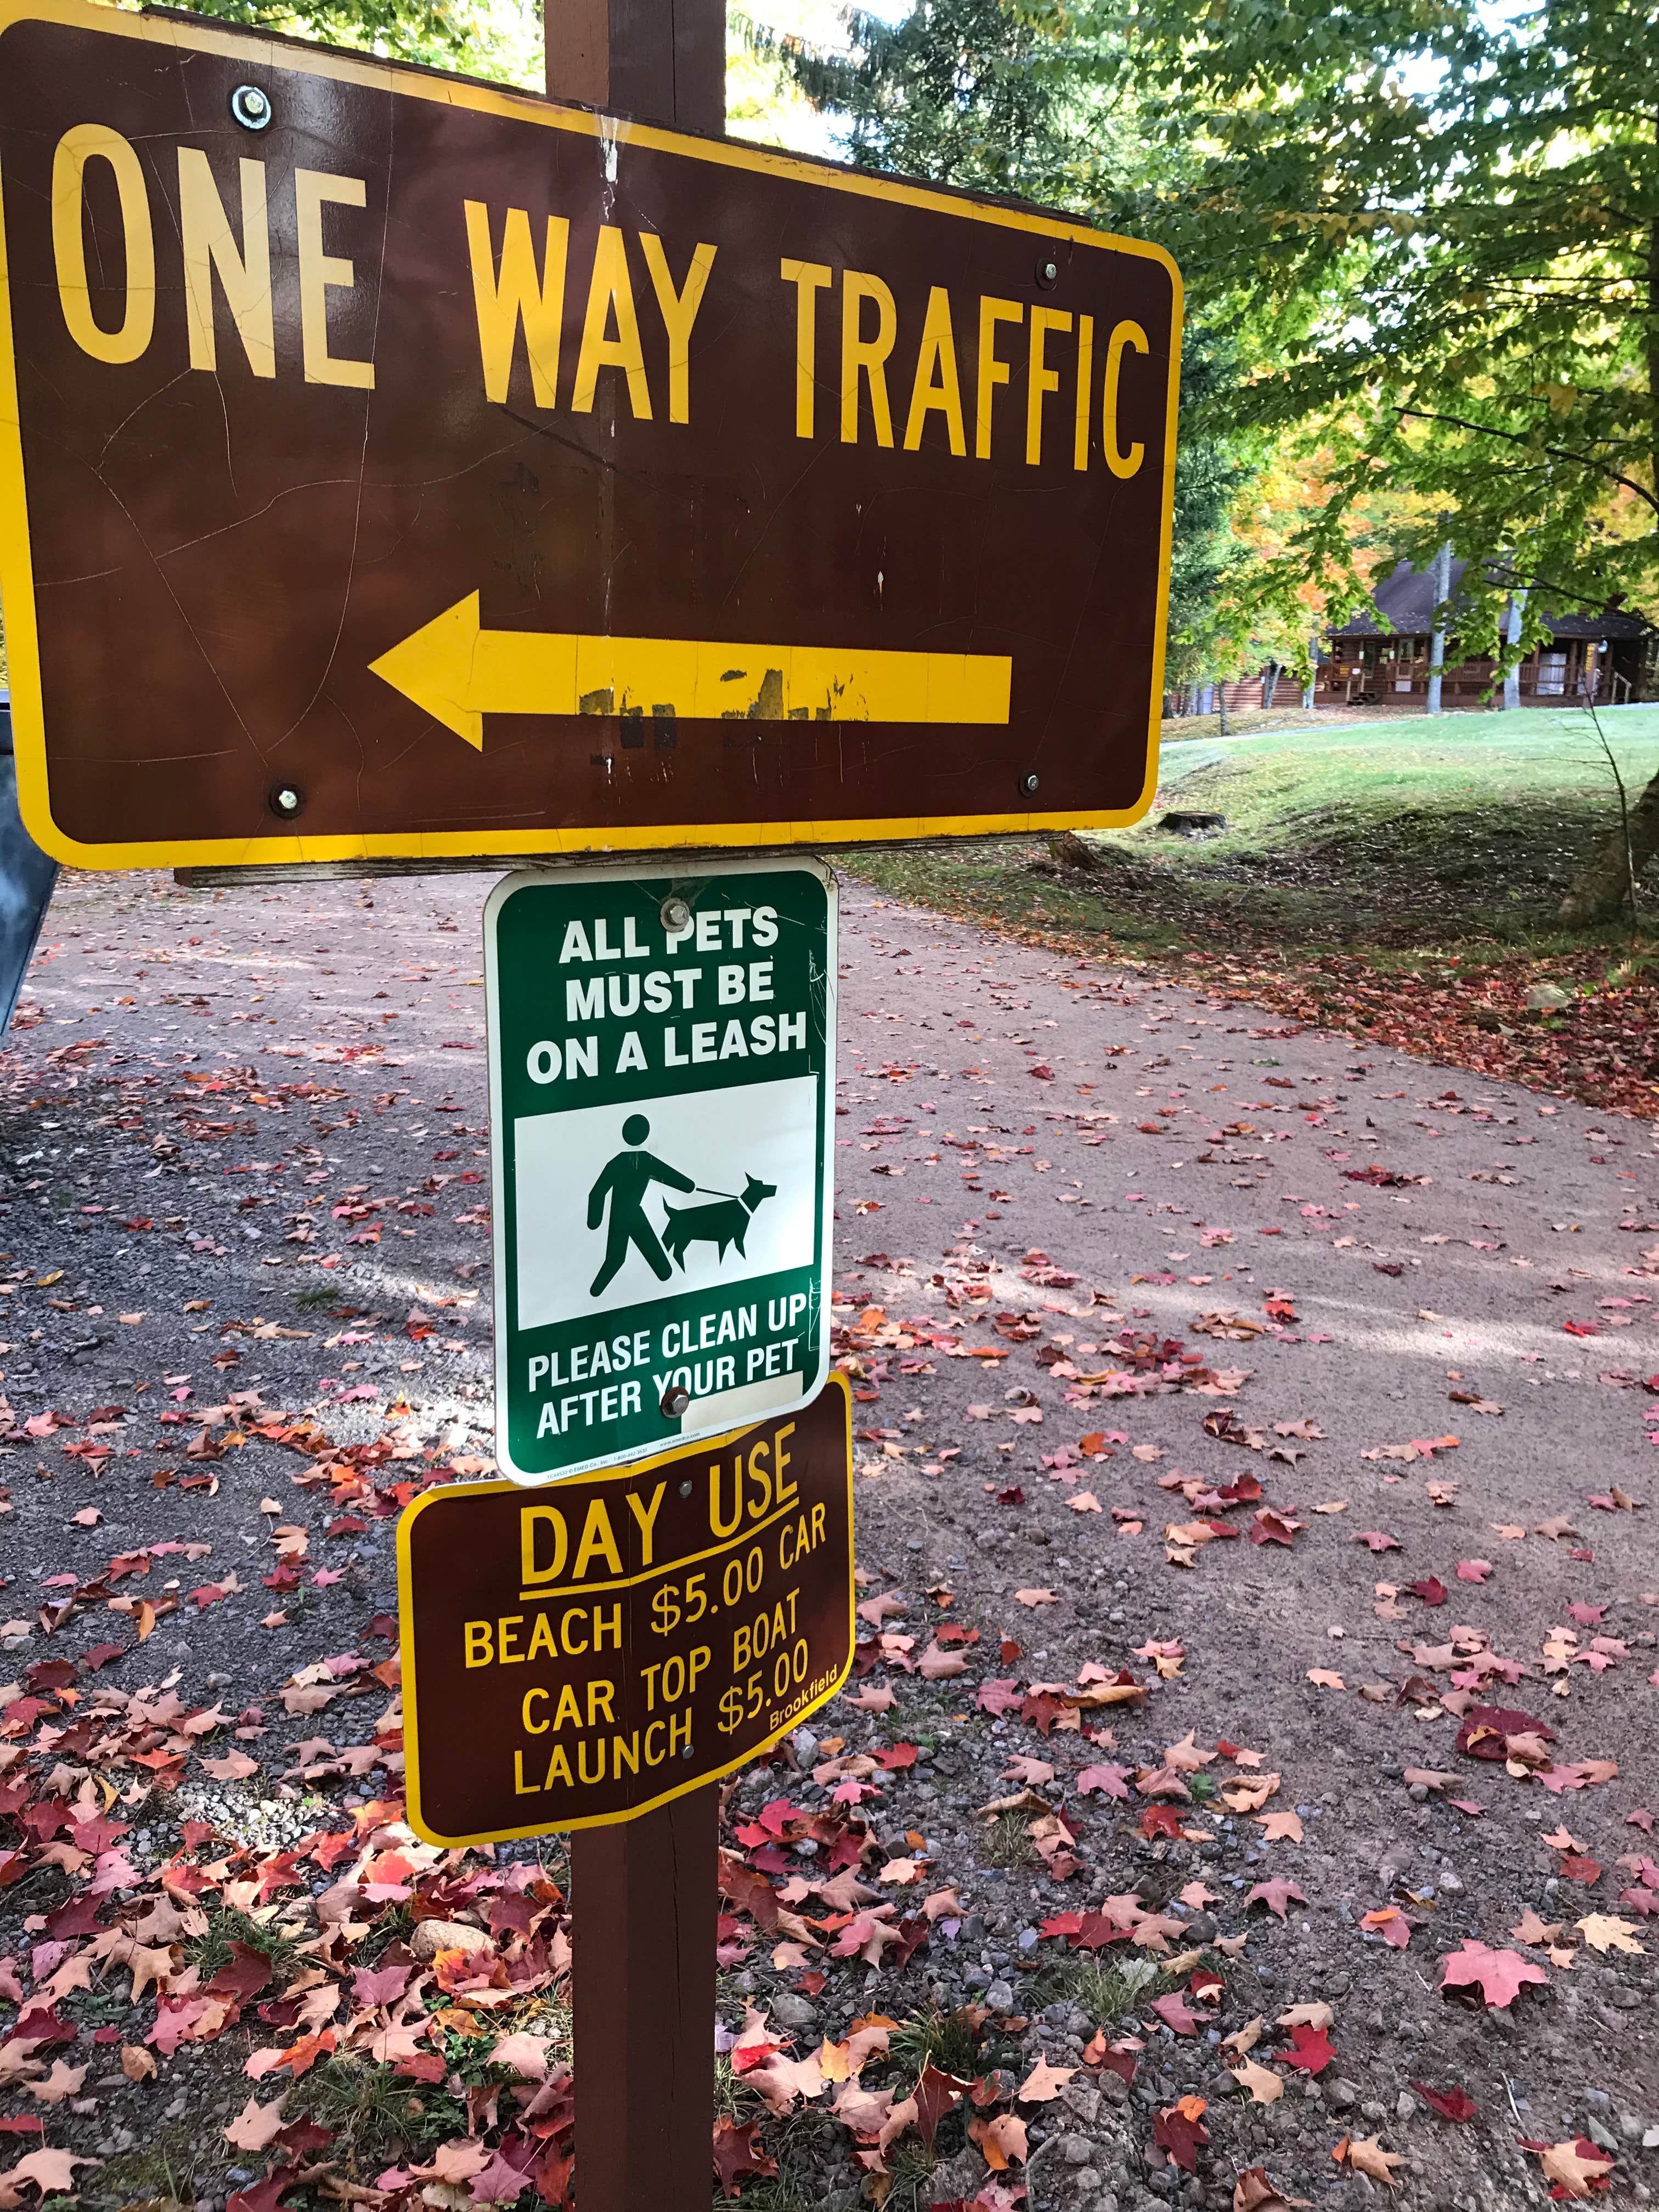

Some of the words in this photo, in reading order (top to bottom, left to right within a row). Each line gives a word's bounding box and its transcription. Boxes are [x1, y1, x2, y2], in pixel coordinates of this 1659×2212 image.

[52, 123, 375, 389] ONE
[464, 199, 718, 424] WAY
[781, 257, 1149, 478] TRAFFIC
[559, 917, 650, 963] ALL
[666, 906, 778, 955] PETS
[566, 968, 702, 1022] MUST
[718, 961, 775, 1006] BE
[526, 1036, 599, 1085] ON
[615, 1031, 648, 1074] A
[664, 1011, 807, 1067] LEASH
[528, 1330, 651, 1392] PLEASE
[662, 1304, 757, 1358] CLEAN
[768, 1293, 806, 1331] UP
[537, 1380, 641, 1439] AFTER
[652, 1358, 735, 1407] YOUR
[747, 1338, 799, 1382] PET
[520, 1481, 667, 1585] DAY
[709, 1421, 798, 1538] USE
[464, 1602, 622, 1669] BEACH
[651, 1546, 763, 1637] $5.00
[780, 1502, 826, 1571] CAR
[522, 1679, 614, 1735] CAR
[640, 1645, 711, 1711] TOP
[733, 1588, 800, 1673] BOAT
[770, 1663, 838, 1731] Brookfield
[514, 1707, 692, 1796] LAUNCH
[717, 1638, 809, 1735] $5.00
